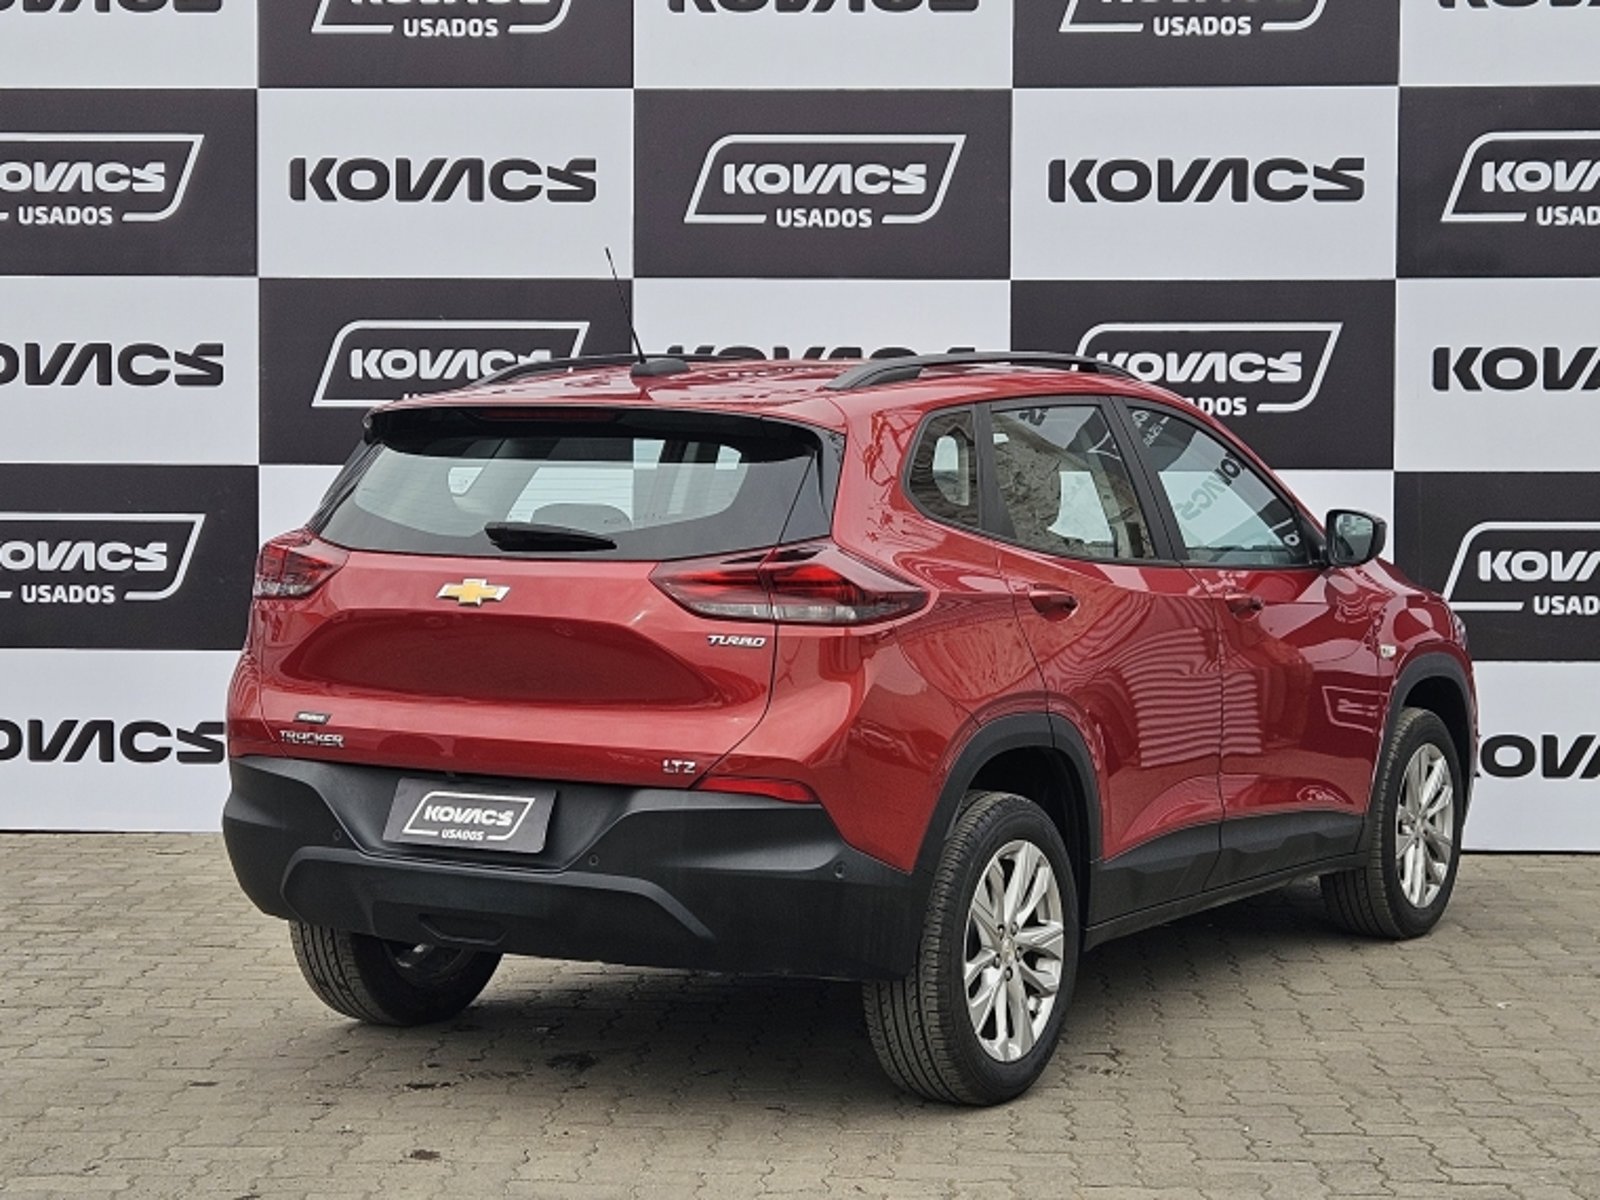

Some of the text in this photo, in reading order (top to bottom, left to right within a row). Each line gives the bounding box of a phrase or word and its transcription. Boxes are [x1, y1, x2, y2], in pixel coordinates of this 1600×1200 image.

[403, 18, 498, 37] USADOS
[1153, 17, 1251, 36] USADOS
[289, 157, 596, 202] KOVACS
[723, 163, 927, 194] KOVACS
[1048, 157, 1364, 203] KOVACS
[18, 206, 113, 225] USADOS
[775, 208, 872, 228] USADOS
[0, 541, 168, 571] OVACS
[21, 585, 116, 603] USADOS
[707, 635, 767, 648] TURBO
[662, 759, 696, 774] LTZ
[424, 805, 515, 827] KOVACS
[441, 829, 484, 842] USADOS
